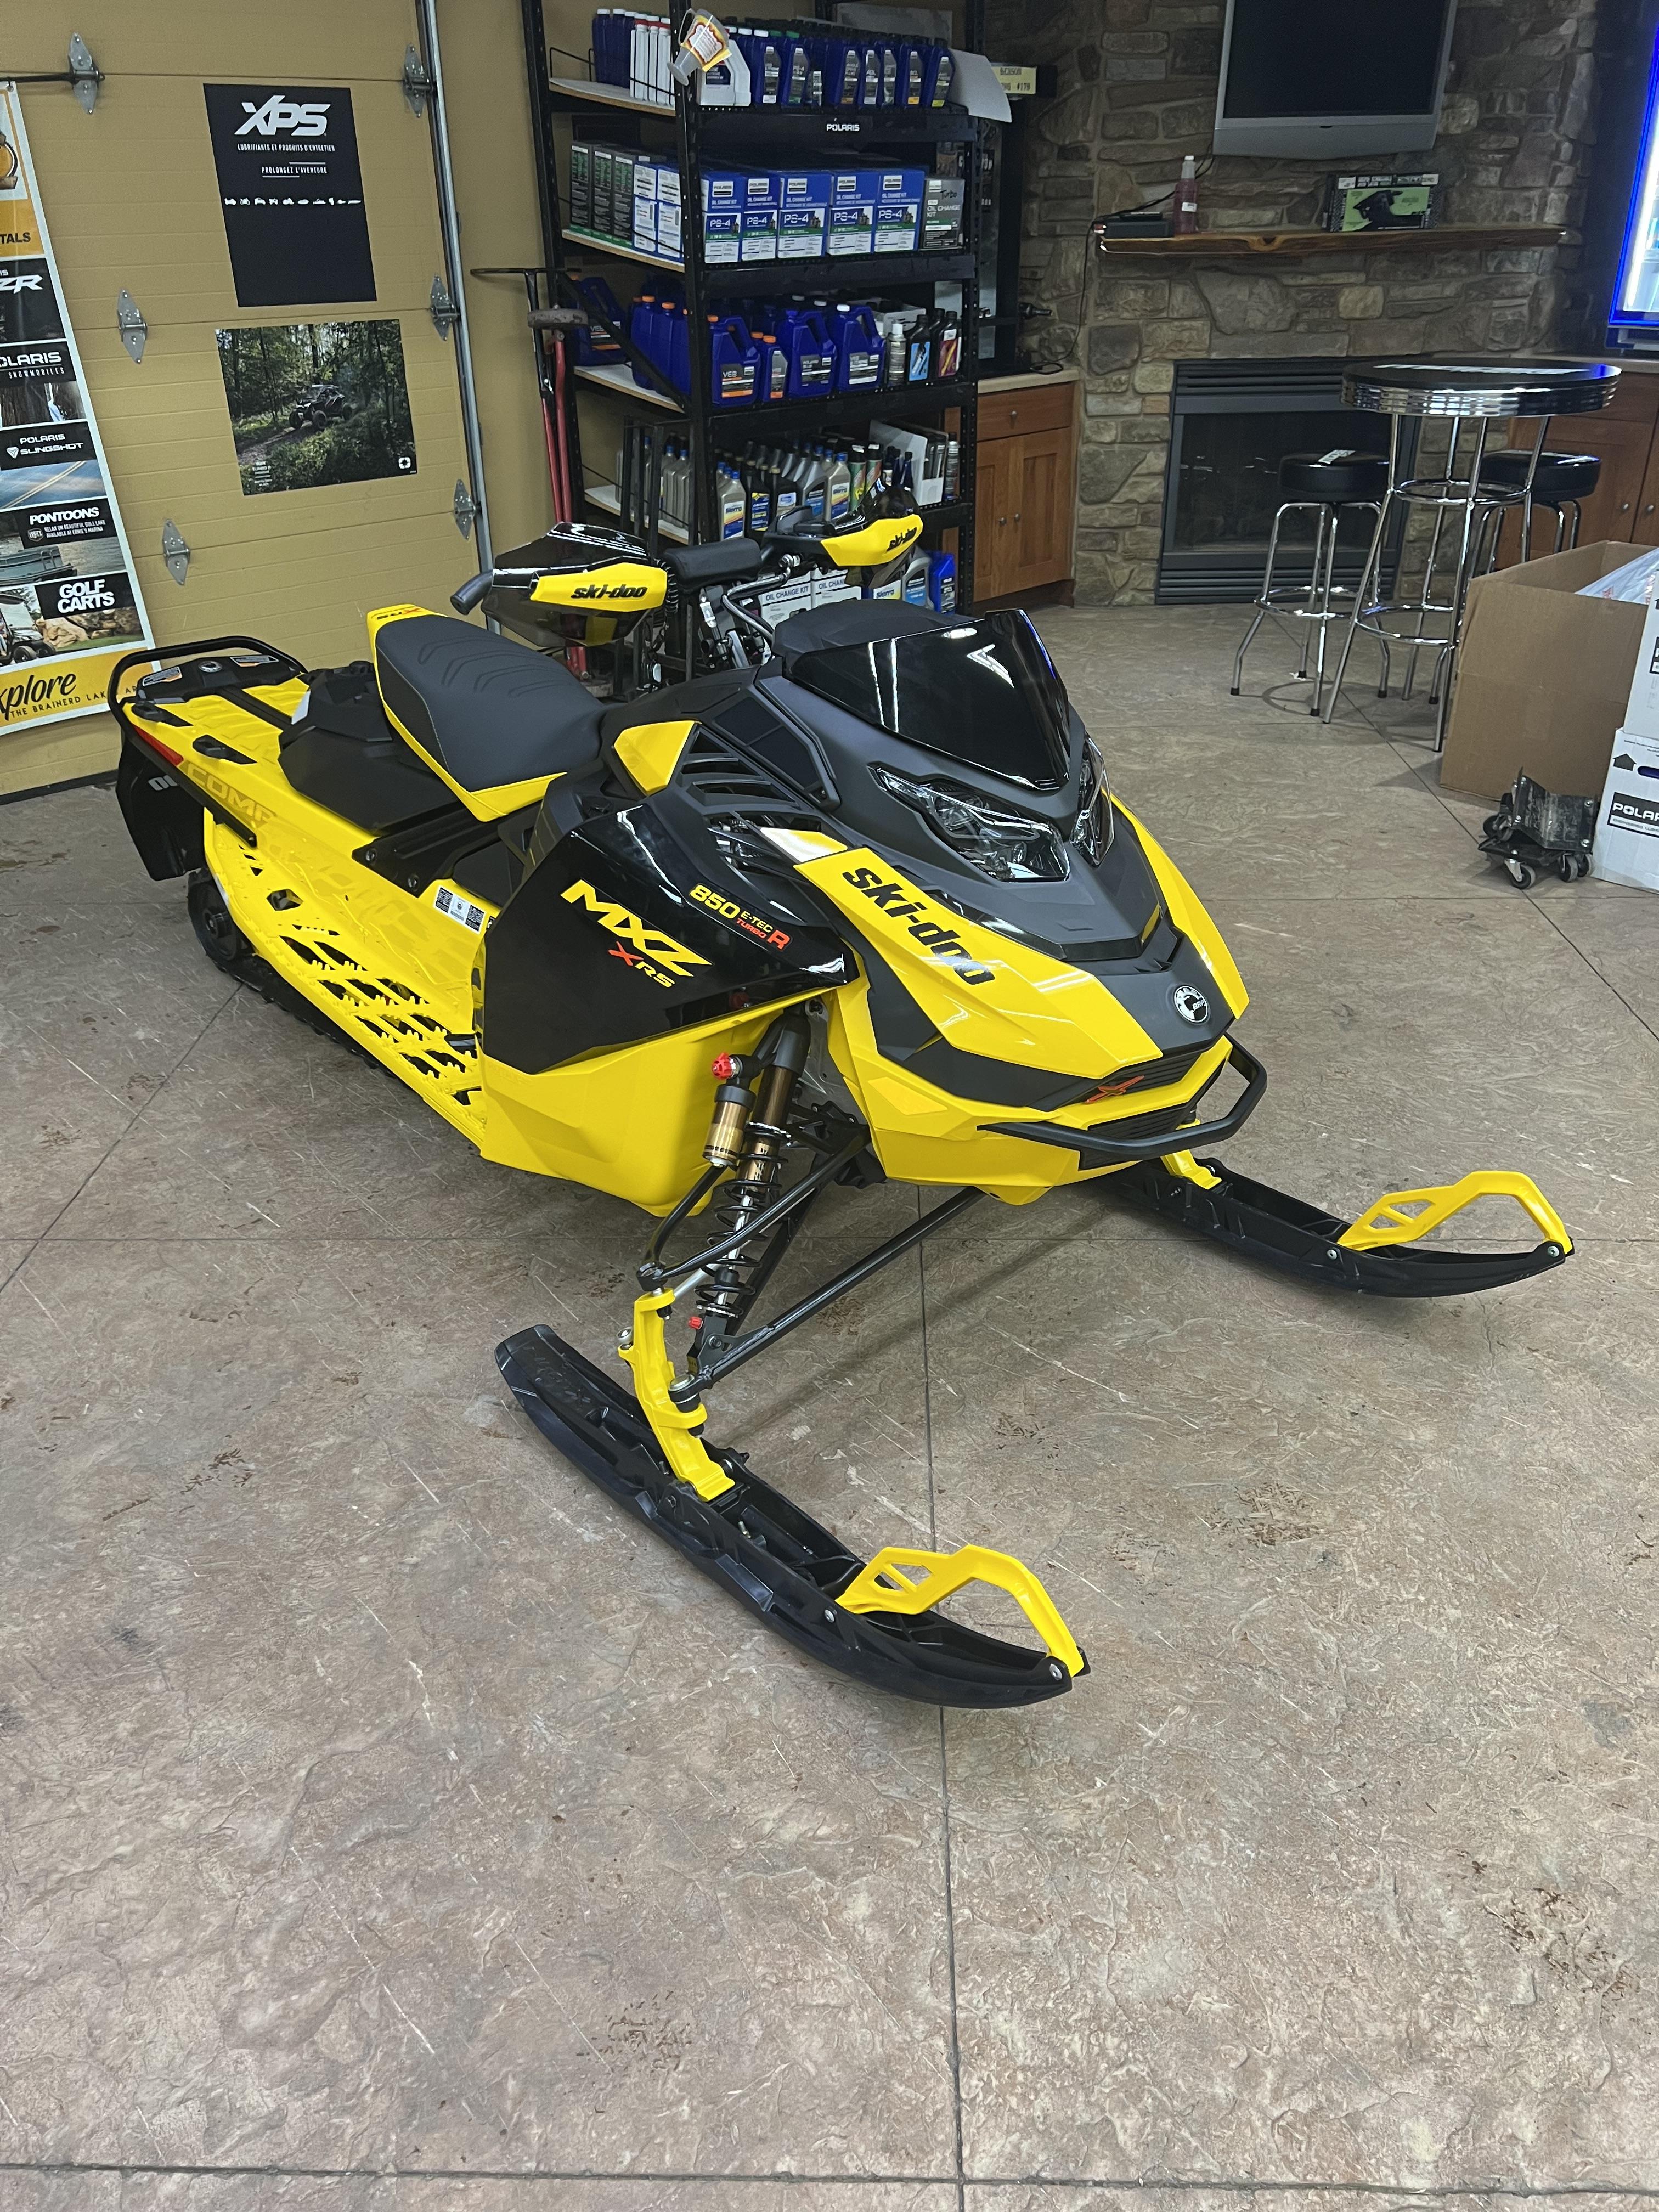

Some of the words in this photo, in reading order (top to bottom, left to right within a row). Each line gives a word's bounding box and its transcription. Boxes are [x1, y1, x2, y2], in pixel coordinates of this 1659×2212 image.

[234, 95, 331, 136] XPS
[827, 123, 860, 132] POLARIS
[747, 216, 767, 225] PS-4
[783, 213, 809, 224] PS-4
[834, 211, 858, 222] PS-4
[878, 209, 902, 219] PS-4
[710, 219, 730, 228] PS-4
[8, 367, 64, 379] SNOWMOBILES
[20, 433, 65, 445] POLARIS
[20, 442, 83, 455] SLINGSHOT
[30, 507, 99, 526] PONTOONS
[59, 579, 105, 600] GOLF
[571, 584, 648, 599] ski-doo
[776, 588, 799, 599] CHANGE
[58, 591, 115, 613] CARTS
[10, 707, 27, 718] THE
[33, 696, 81, 713] BRAINERD
[87, 691, 105, 701] LAK
[690, 884, 741, 919] 850
[741, 911, 774, 933] E-TEC
[560, 879, 713, 977] MXZ
[842, 868, 995, 985] ski-doo
[736, 917, 767, 939] TURBO
[766, 929, 791, 950] R
[1192, 999, 1205, 1011] BRP
